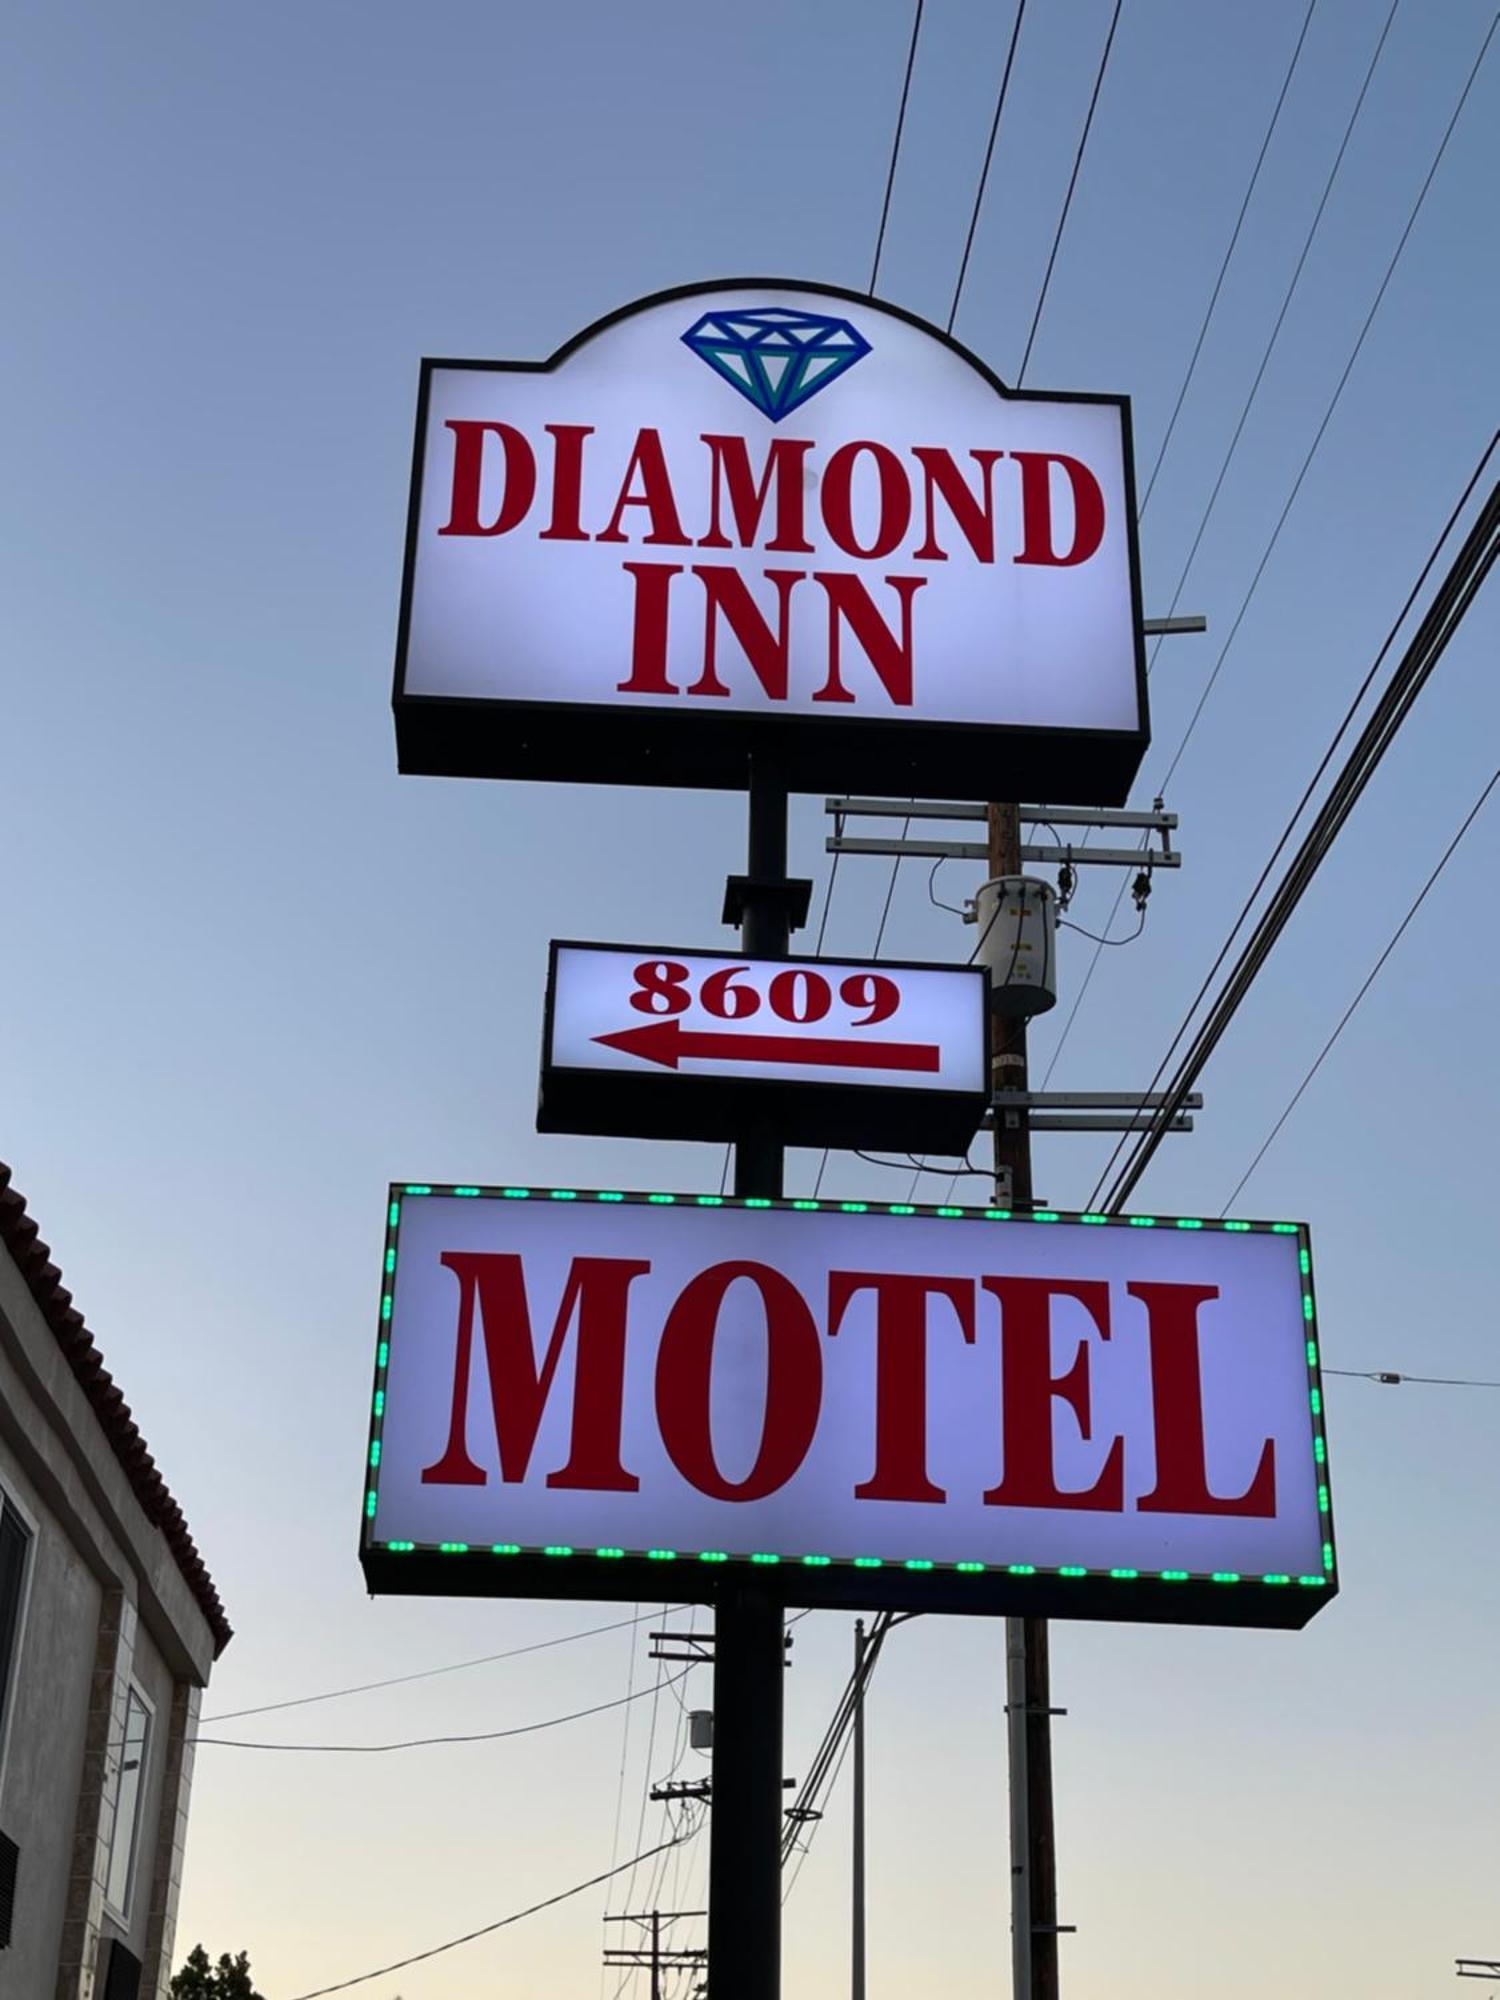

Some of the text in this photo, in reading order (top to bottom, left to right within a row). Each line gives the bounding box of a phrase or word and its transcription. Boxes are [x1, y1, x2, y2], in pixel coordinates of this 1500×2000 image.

[438, 420, 1106, 567] DIAMOND
[617, 562, 928, 706] INN
[629, 961, 900, 1027] 8609
[421, 1251, 1276, 1518] MOTEL
